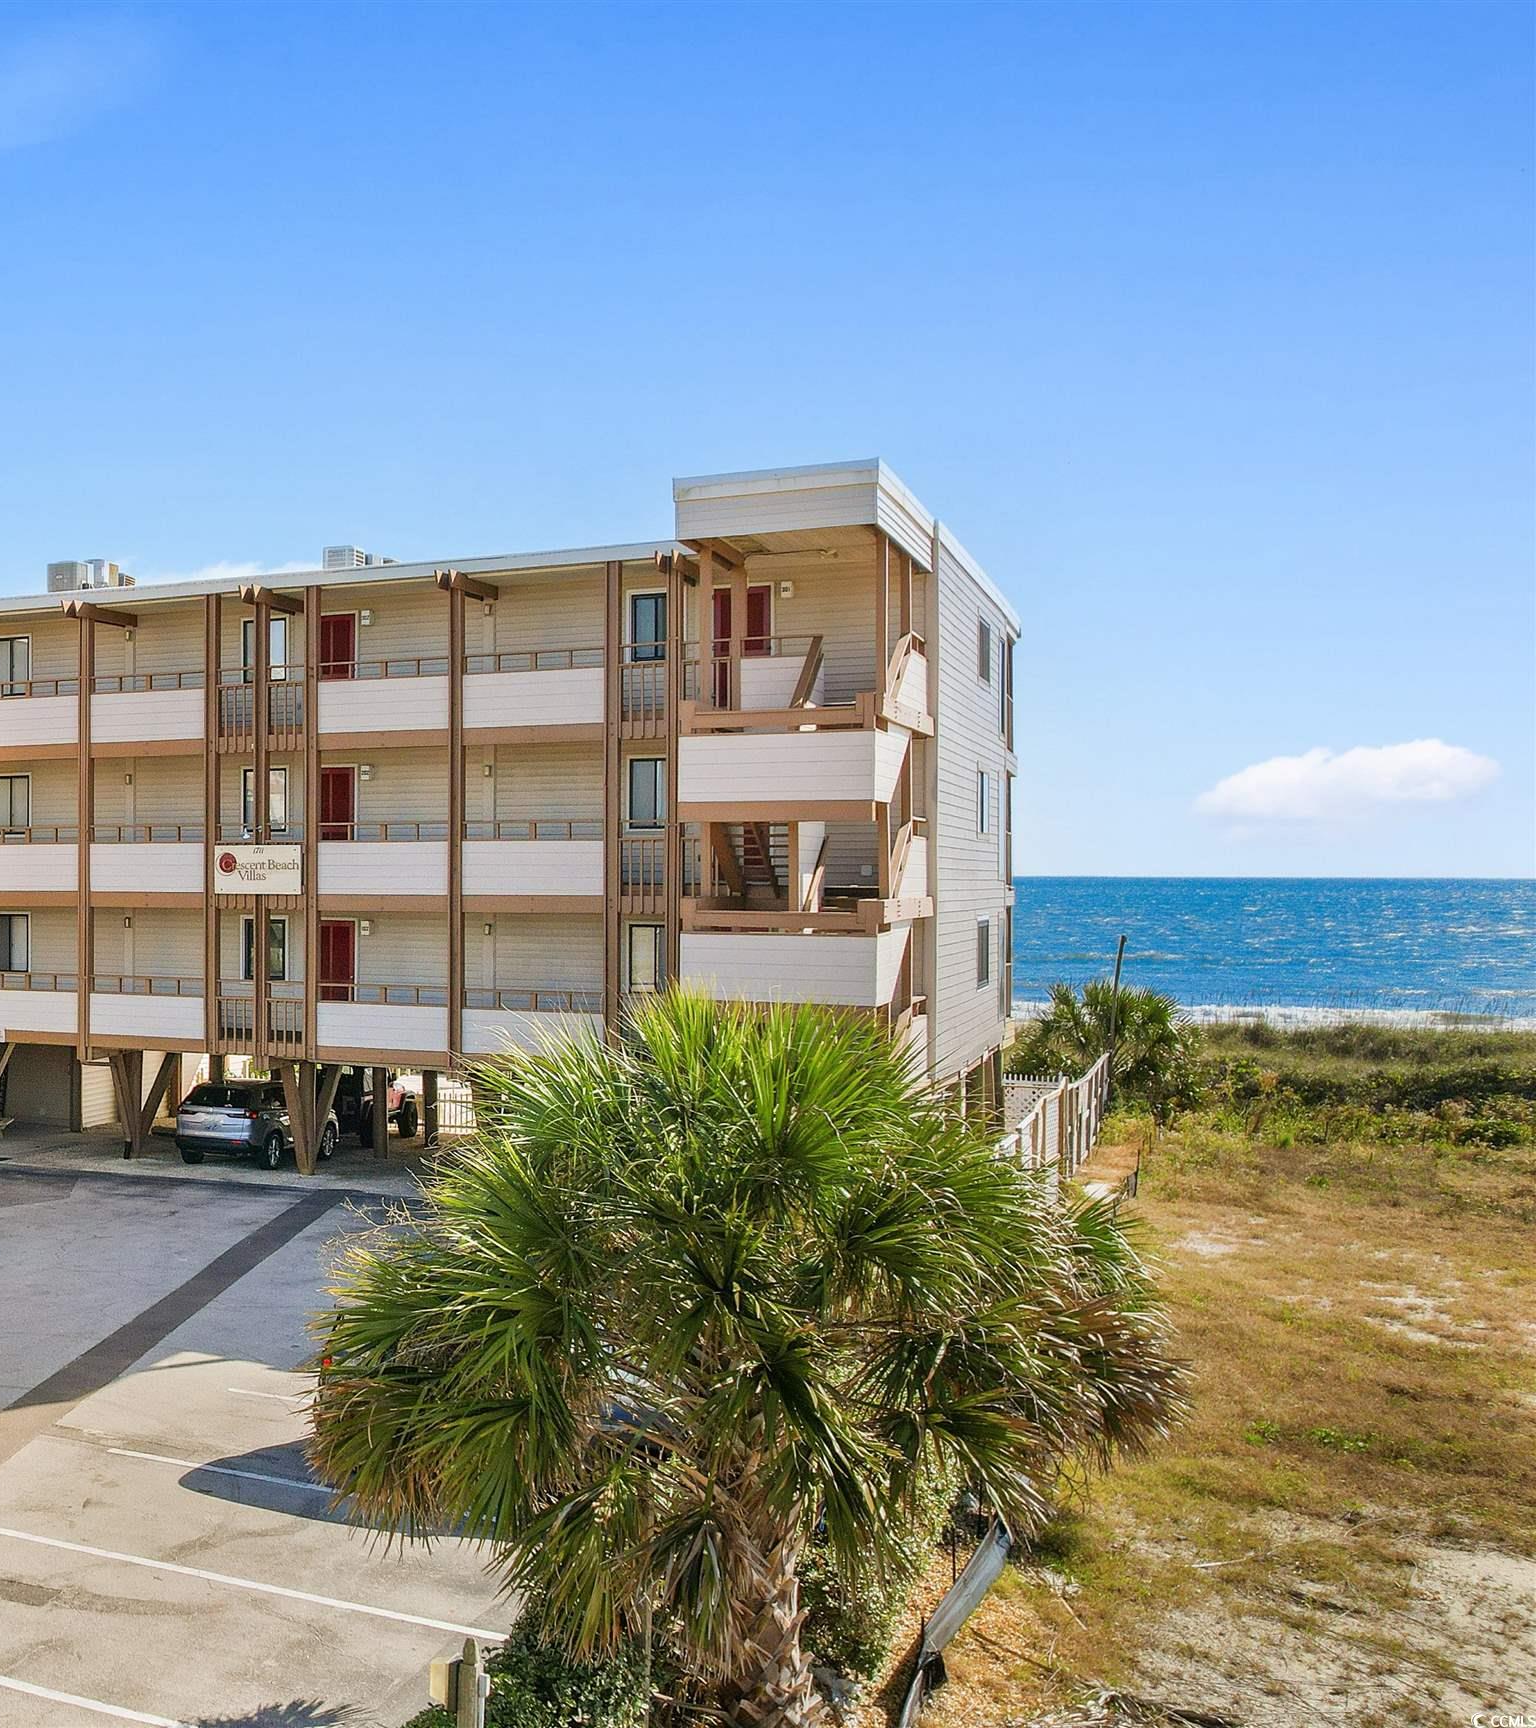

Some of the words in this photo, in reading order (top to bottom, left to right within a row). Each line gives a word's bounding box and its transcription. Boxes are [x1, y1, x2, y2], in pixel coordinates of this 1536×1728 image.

[221, 859, 266, 870] Crescent
[267, 859, 299, 870] Beach
[238, 870, 267, 880] Villas
